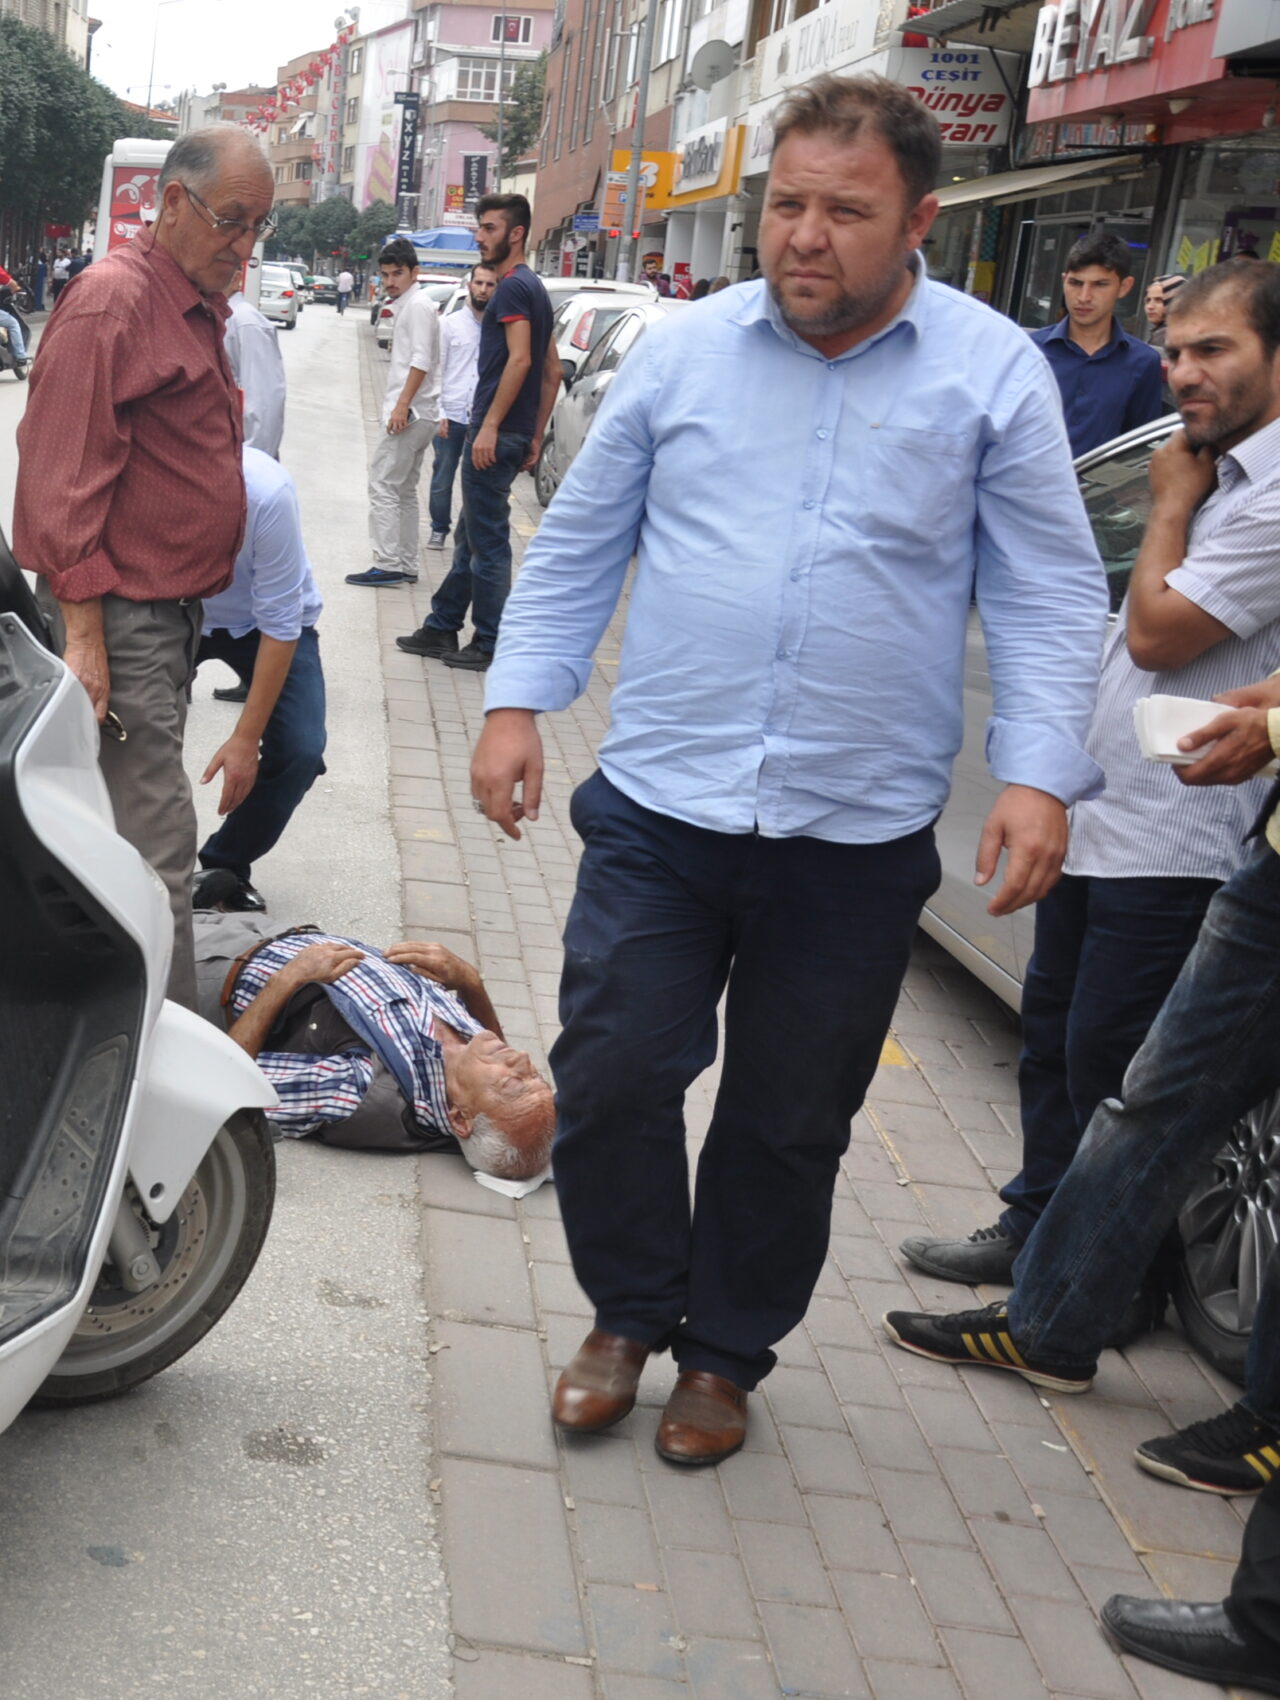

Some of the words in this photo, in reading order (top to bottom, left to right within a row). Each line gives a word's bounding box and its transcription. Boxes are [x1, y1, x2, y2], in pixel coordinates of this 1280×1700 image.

[795, 11, 838, 74] FLORA
[1027, 0, 1156, 89] BEYAZ
[930, 53, 981, 65] 1001
[921, 68, 983, 82] ÇEŞİT
[905, 86, 1006, 117] Dünya
[939, 123, 998, 142] zarı
